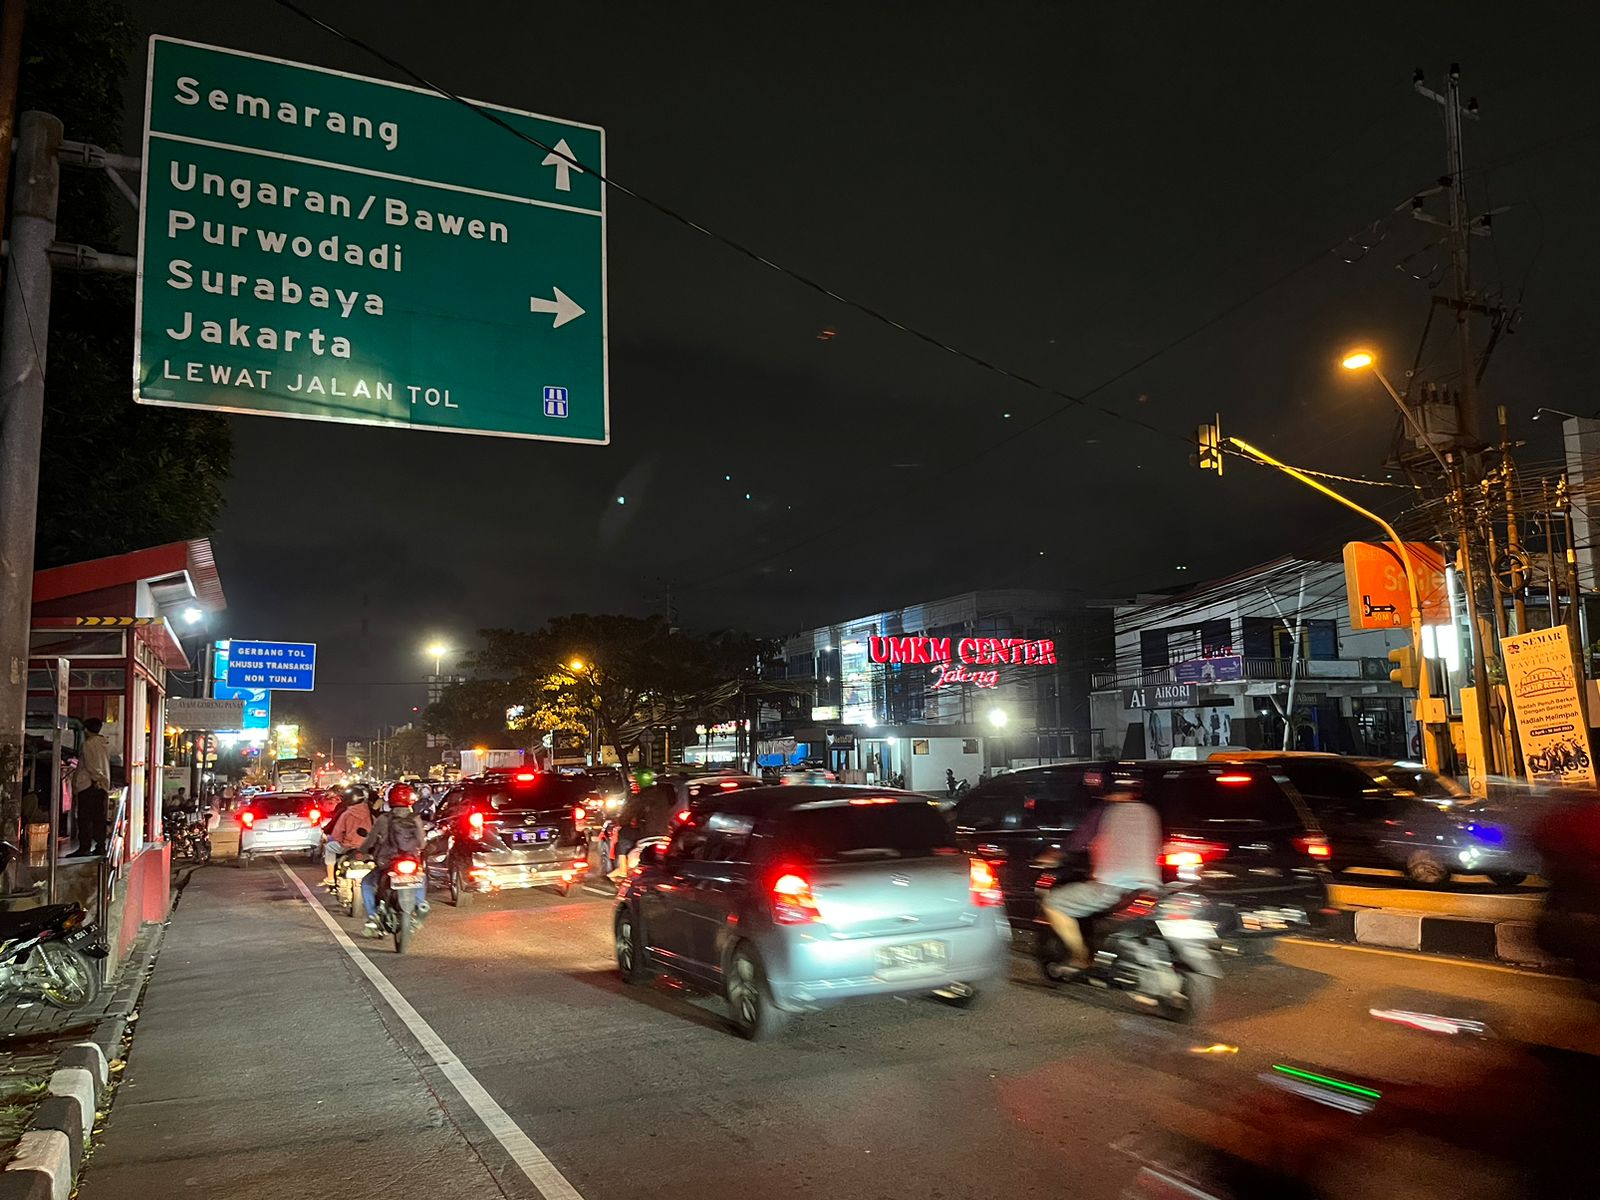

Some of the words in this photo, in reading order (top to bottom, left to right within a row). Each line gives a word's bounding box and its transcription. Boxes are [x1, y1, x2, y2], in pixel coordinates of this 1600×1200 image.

[174, 76, 399, 151] Semarang
[169, 161, 508, 244] Ungaran/Bawen
[168, 210, 402, 273] Purwodadi
[166, 259, 385, 318] Surabaya
[166, 312, 351, 359] Jakarta
[163, 359, 273, 391] LEWAT
[287, 373, 393, 402] JALAN
[408, 385, 459, 409] TOL
[238, 647, 284, 657] GERBANG
[288, 649, 306, 658] TOL
[869, 636, 952, 664] UMKM
[958, 637, 1057, 665] CENTER
[1523, 632, 1561, 646] SEMAR
[229, 660, 264, 669] KHUSUS
[266, 661, 313, 671] TRANSAKSI
[244, 674, 265, 682] NON
[269, 675, 297, 683] TUNAI
[1130, 689, 1146, 708] Ai
[1155, 685, 1190, 699] AiKORI
[1545, 711, 1579, 721] Melimpah
